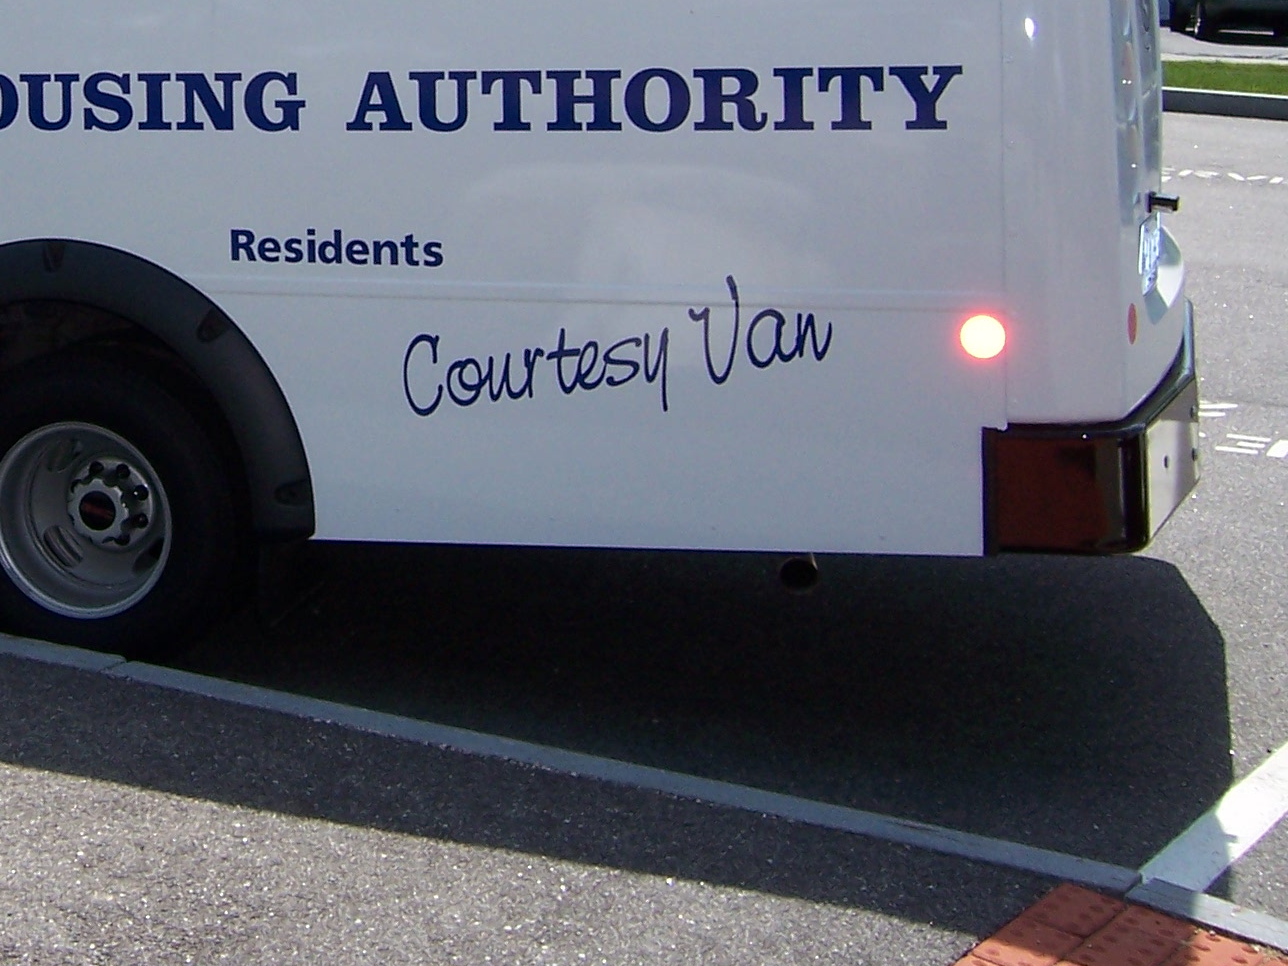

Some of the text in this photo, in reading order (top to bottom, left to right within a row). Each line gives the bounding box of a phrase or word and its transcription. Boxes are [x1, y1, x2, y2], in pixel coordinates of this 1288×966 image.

[346, 66, 962, 132] AUTHORITY
[230, 229, 444, 267] Residents
[403, 274, 833, 416] Courtesy Van
